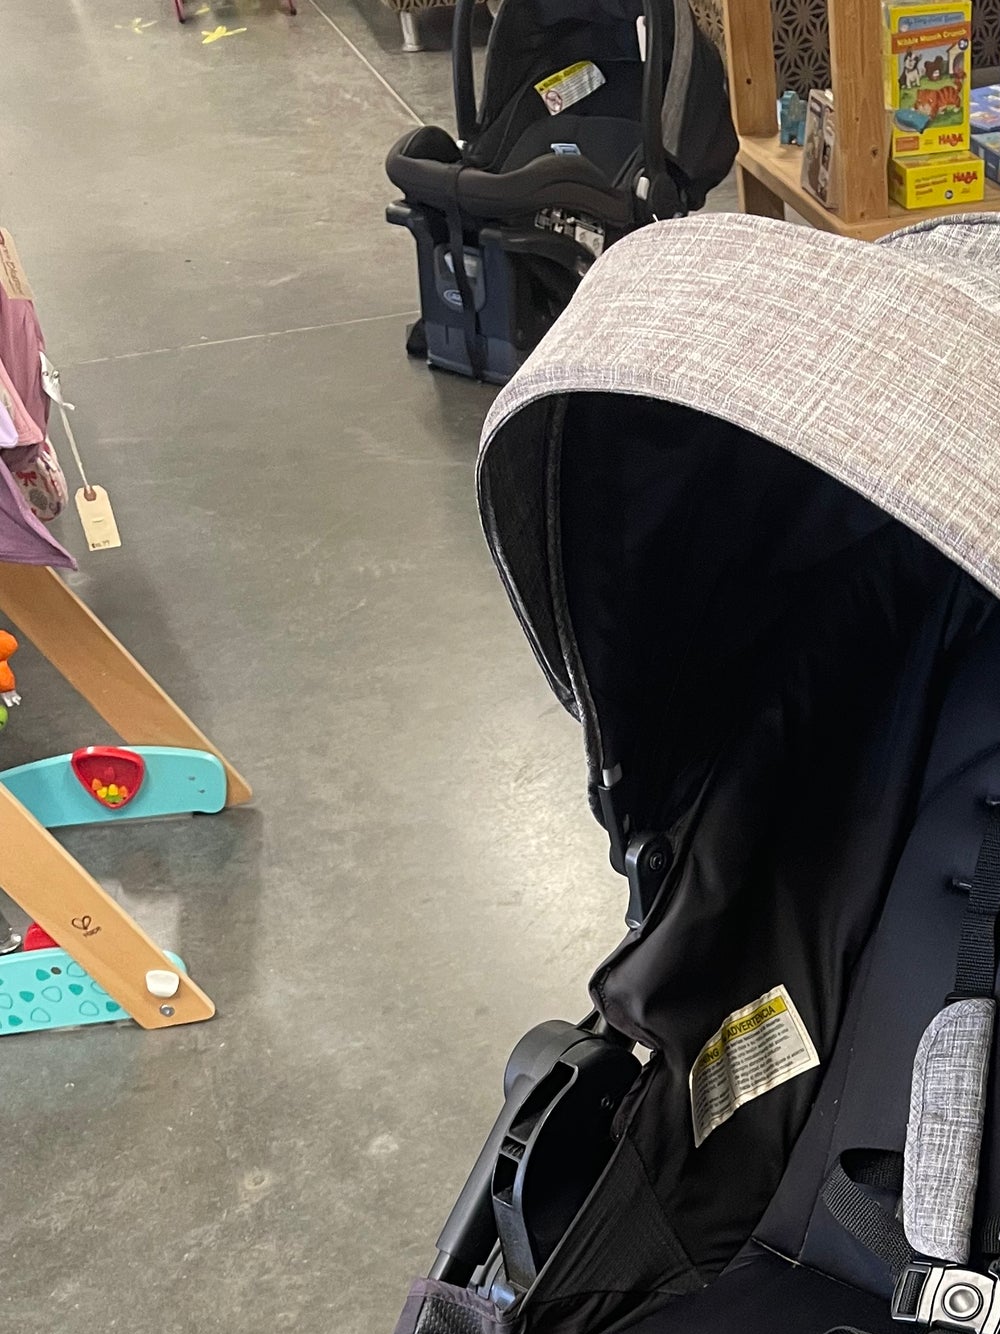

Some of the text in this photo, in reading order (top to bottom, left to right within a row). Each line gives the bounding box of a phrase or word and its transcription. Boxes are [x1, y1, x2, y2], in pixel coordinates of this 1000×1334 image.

[938, 133, 964, 147] HABA
[953, 171, 979, 184] HABA
[726, 1005, 776, 1039] ADVERTENCIA
